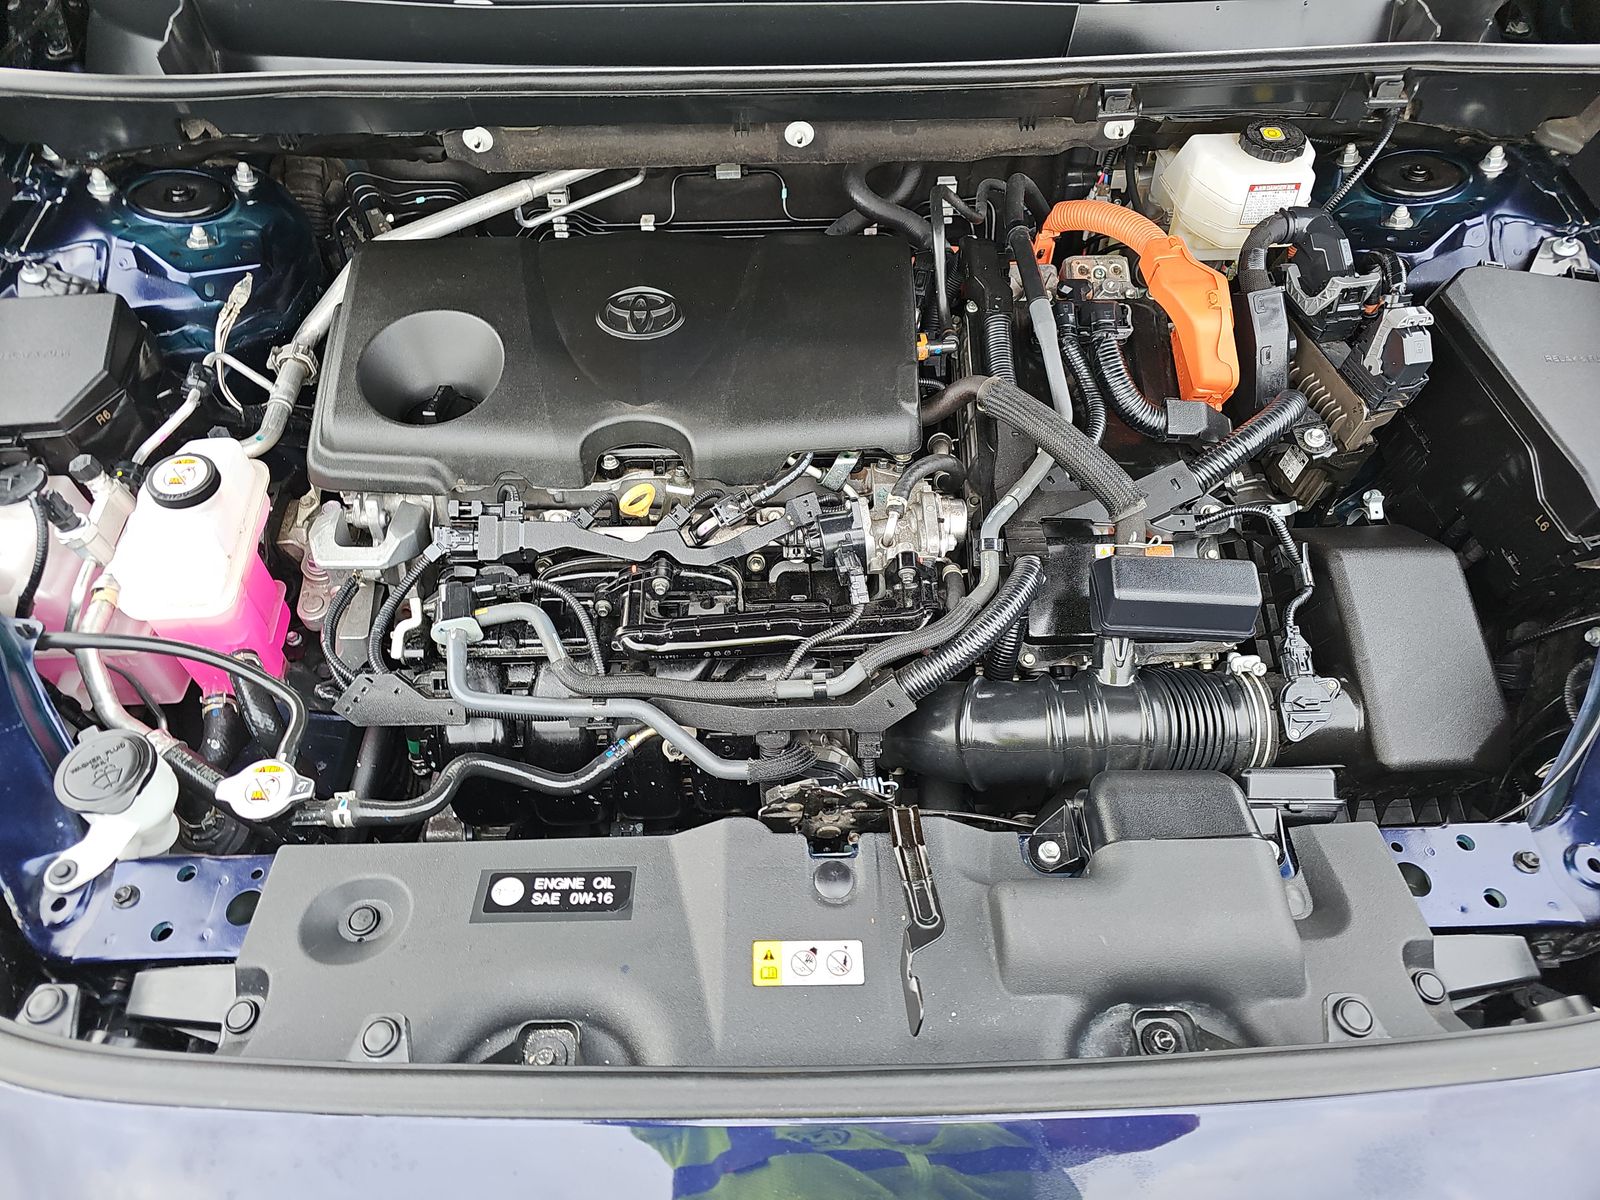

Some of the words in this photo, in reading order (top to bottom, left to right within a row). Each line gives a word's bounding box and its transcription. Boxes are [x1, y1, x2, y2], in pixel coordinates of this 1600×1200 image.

[95, 409, 112, 426] R6
[1535, 514, 1550, 532] L6
[105, 742, 127, 756] FLUID
[533, 877, 586, 891] ENGINE
[592, 876, 616, 890] OIL
[530, 891, 561, 906] SAE
[568, 891, 614, 905] 0W-16
